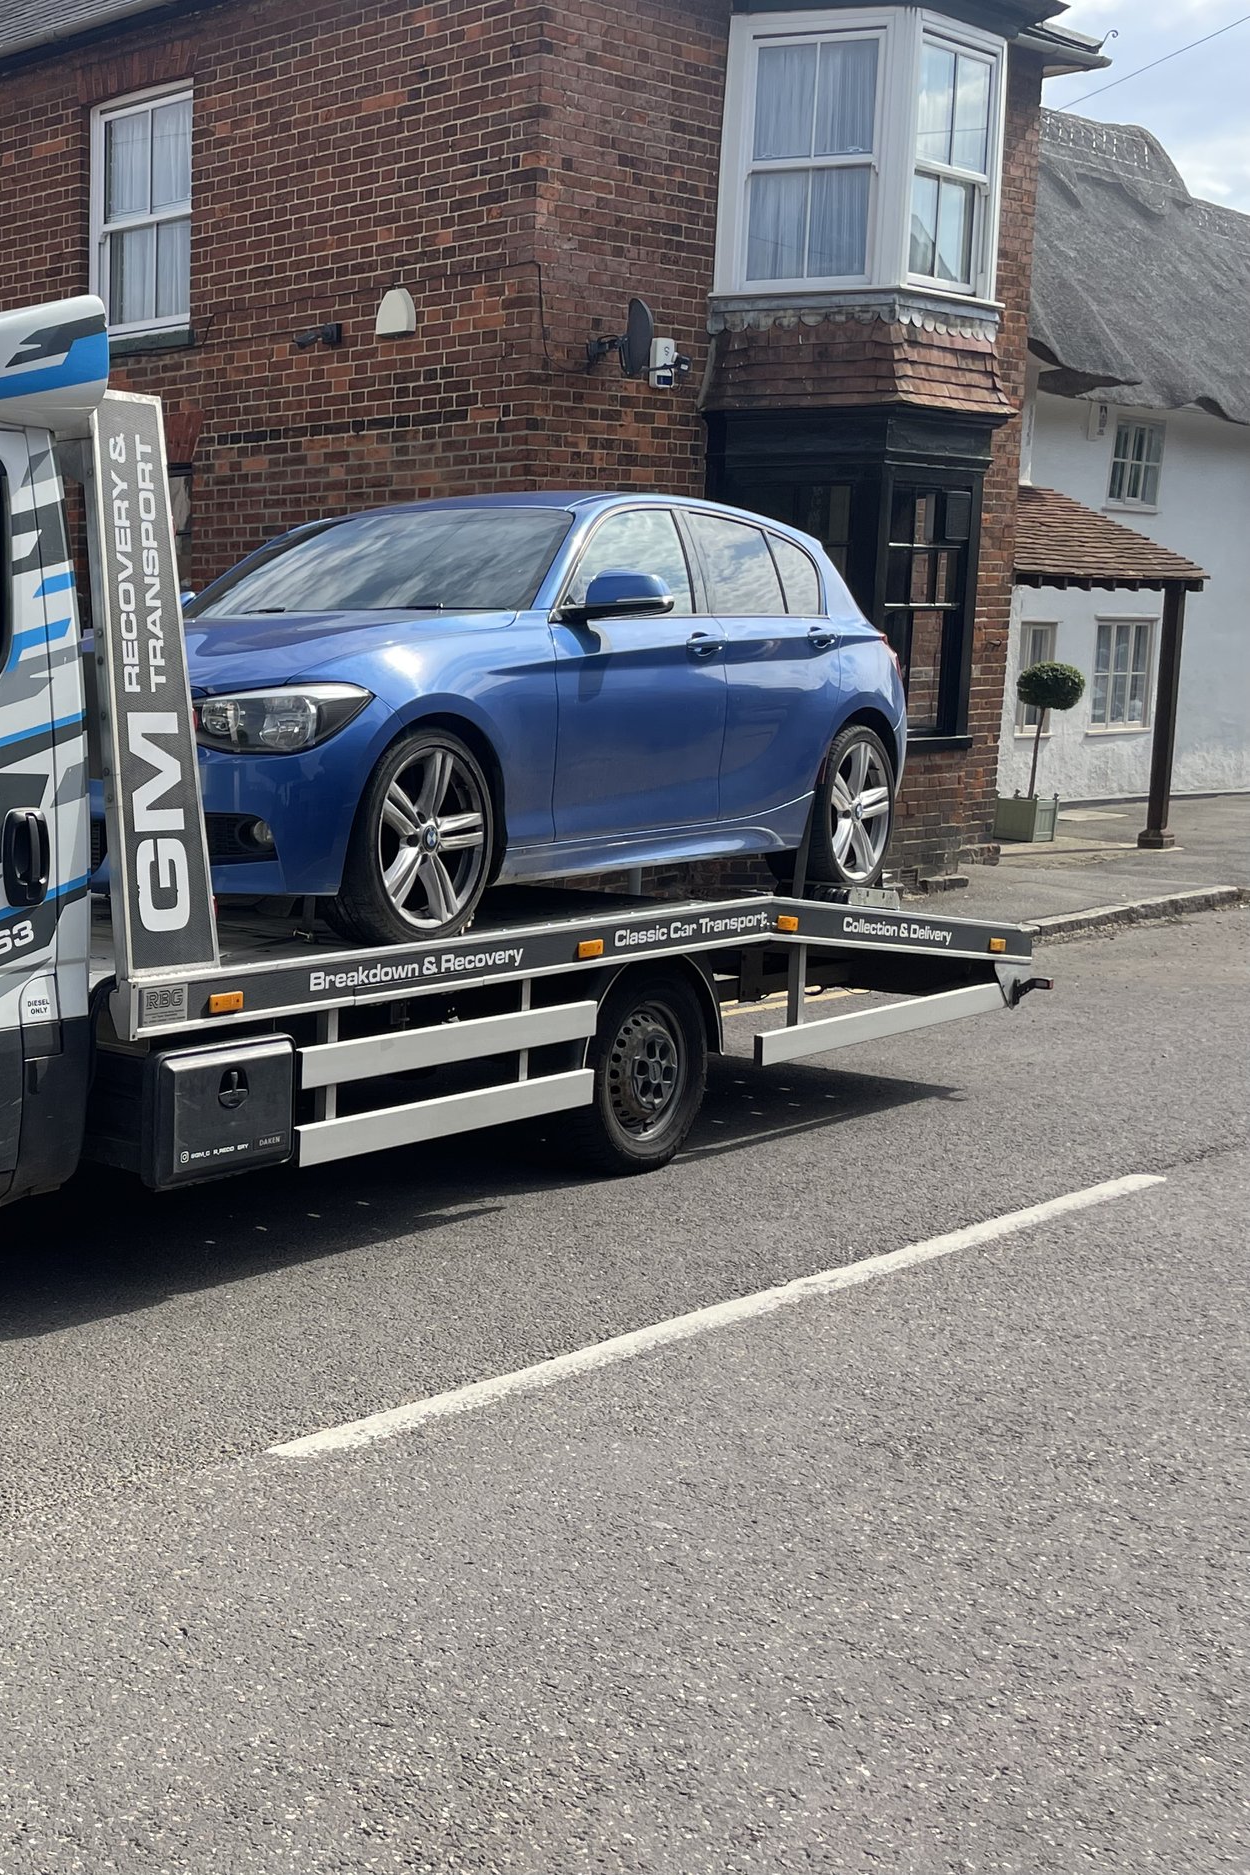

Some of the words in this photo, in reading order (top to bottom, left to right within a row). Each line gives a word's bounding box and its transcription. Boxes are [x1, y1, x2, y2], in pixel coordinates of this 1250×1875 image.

[109, 432, 127, 464] &
[134, 434, 167, 693] TRANSPORT
[109, 470, 141, 694] RECOVERY
[127, 711, 191, 933] GM
[614, 925, 668, 947] Classic
[670, 921, 698, 939] Car
[699, 911, 768, 934] Transport
[843, 916, 898, 937] Collection
[899, 923, 909, 938] &
[910, 924, 952, 946] Delivery
[309, 961, 419, 992] Breakdown
[422, 955, 438, 976] &
[440, 948, 524, 973] Recovery
[27, 999, 50, 1007] DIESEL
[30, 1007, 48, 1015] ONLY
[145, 988, 184, 1010] RBG
[258, 1136, 281, 1147] DAKEN
